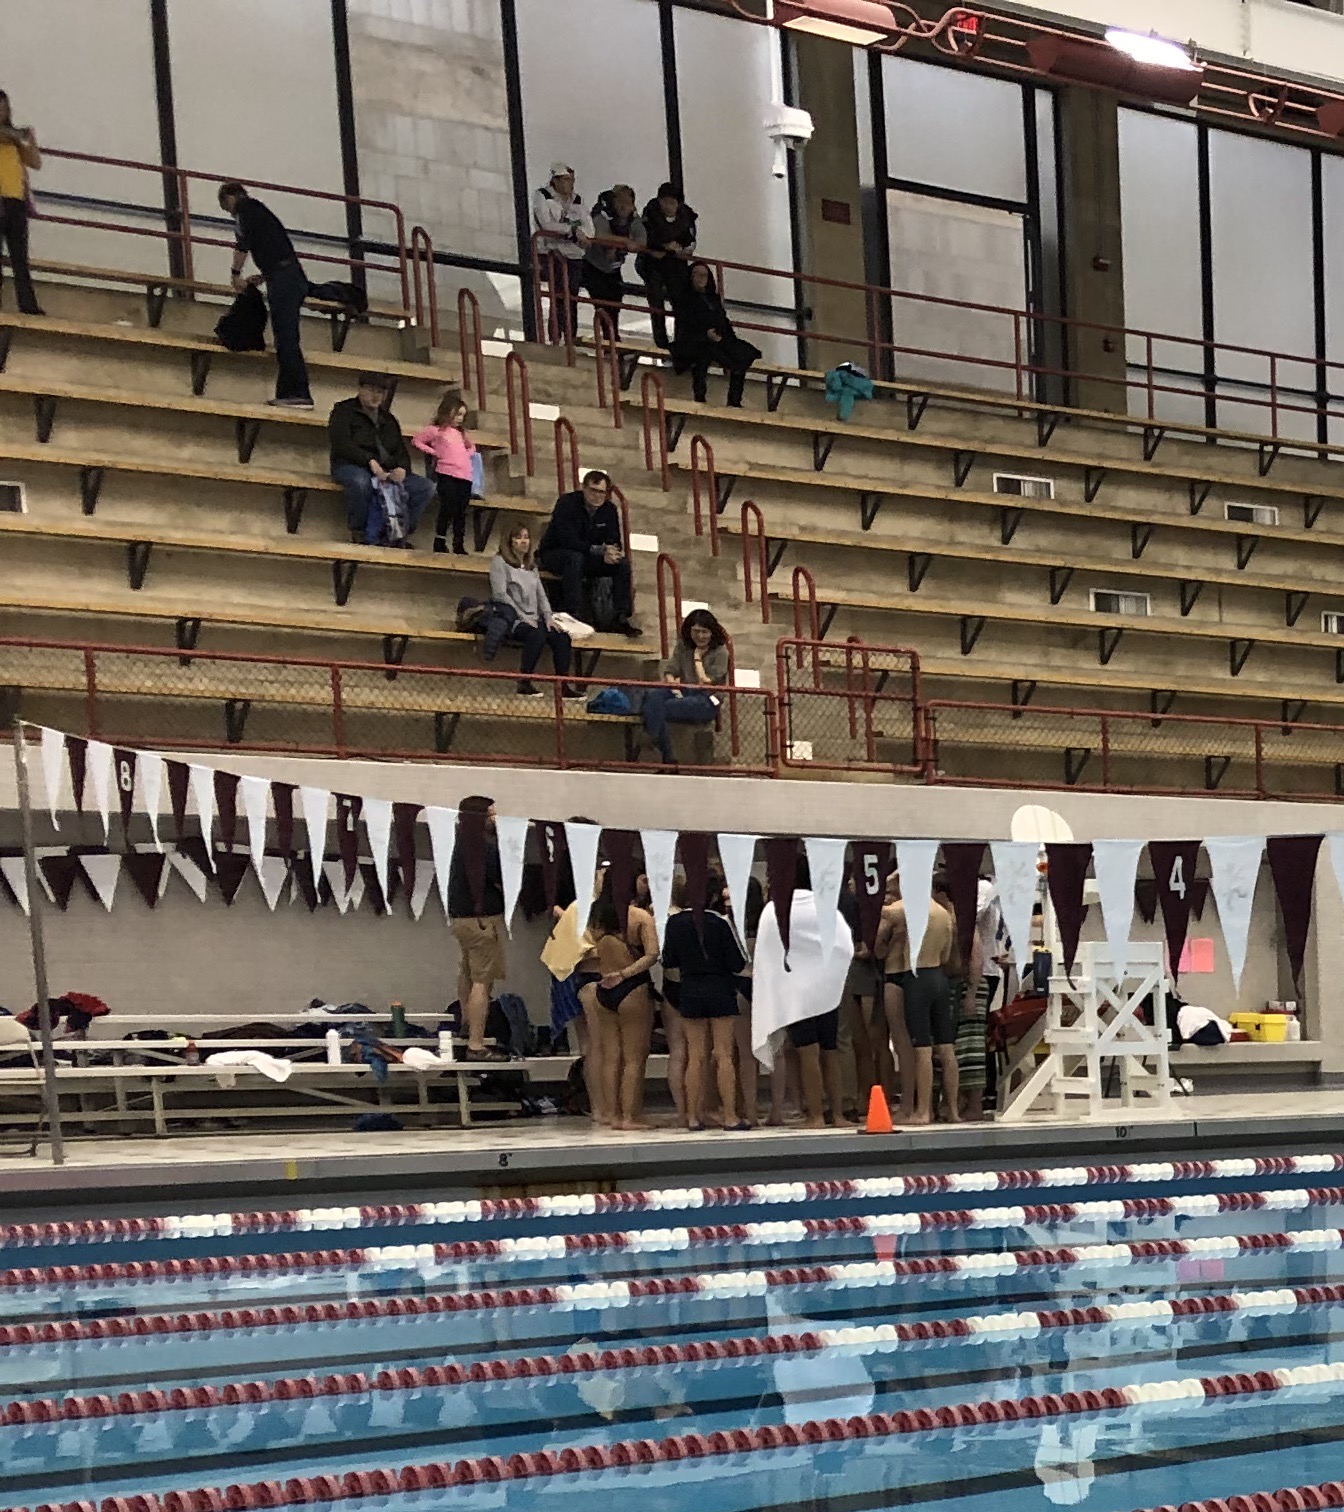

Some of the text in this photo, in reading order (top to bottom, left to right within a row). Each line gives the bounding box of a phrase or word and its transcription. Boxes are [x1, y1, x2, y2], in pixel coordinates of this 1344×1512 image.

[121, 760, 133, 791] 8
[862, 854, 880, 896] 5
[1167, 855, 1186, 900] 4
